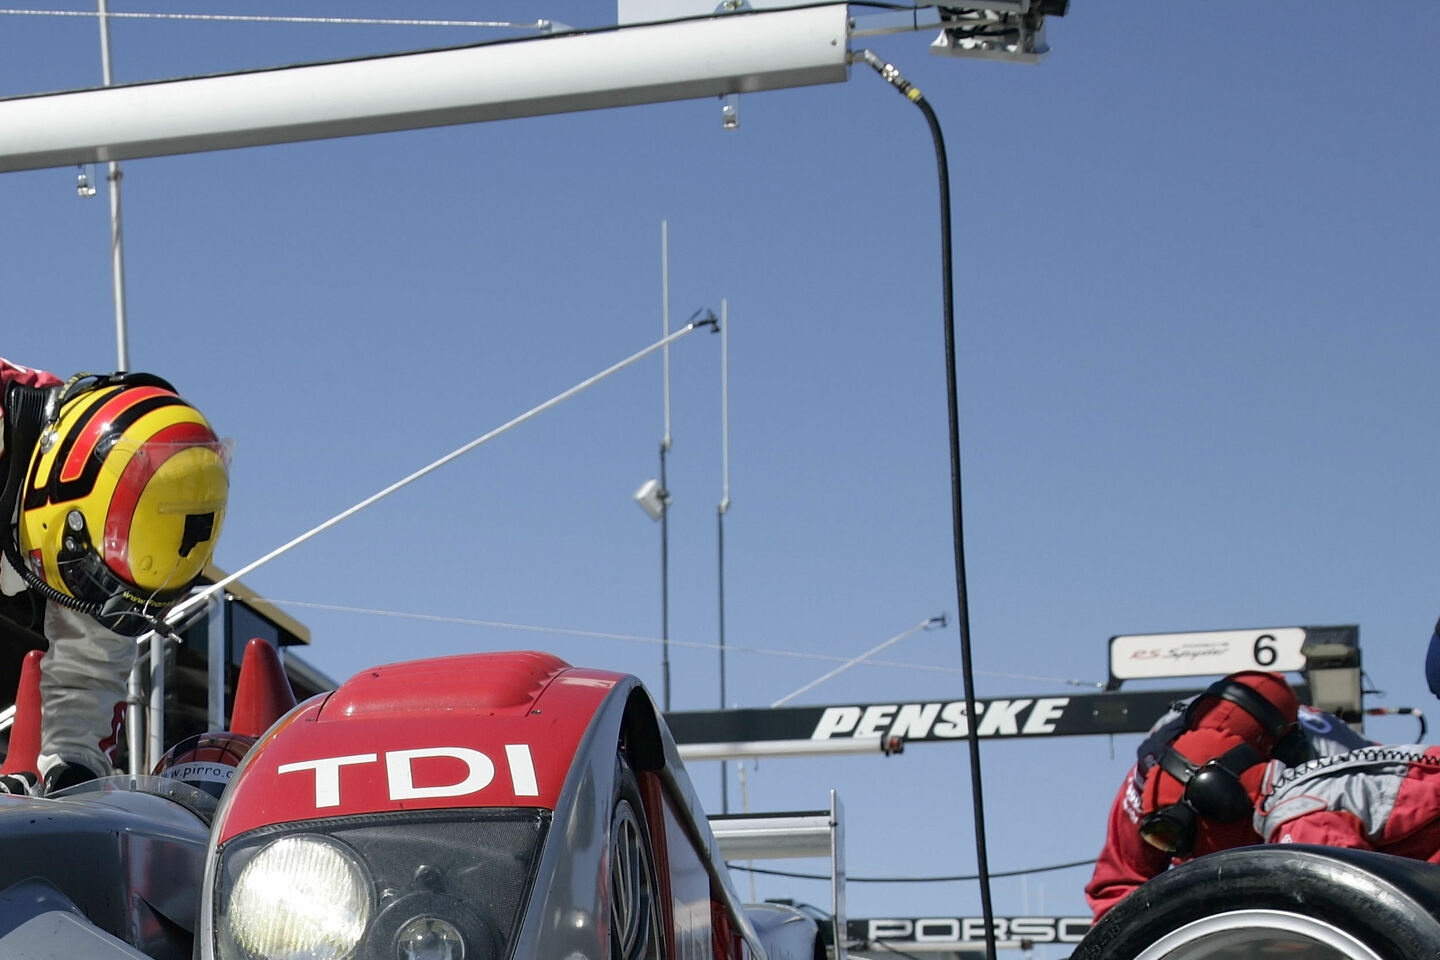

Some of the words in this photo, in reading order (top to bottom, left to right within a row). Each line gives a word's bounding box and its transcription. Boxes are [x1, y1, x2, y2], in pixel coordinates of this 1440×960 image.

[1254, 634, 1277, 666] 6
[810, 697, 1070, 740] PENSKE
[278, 744, 539, 808] TDI
